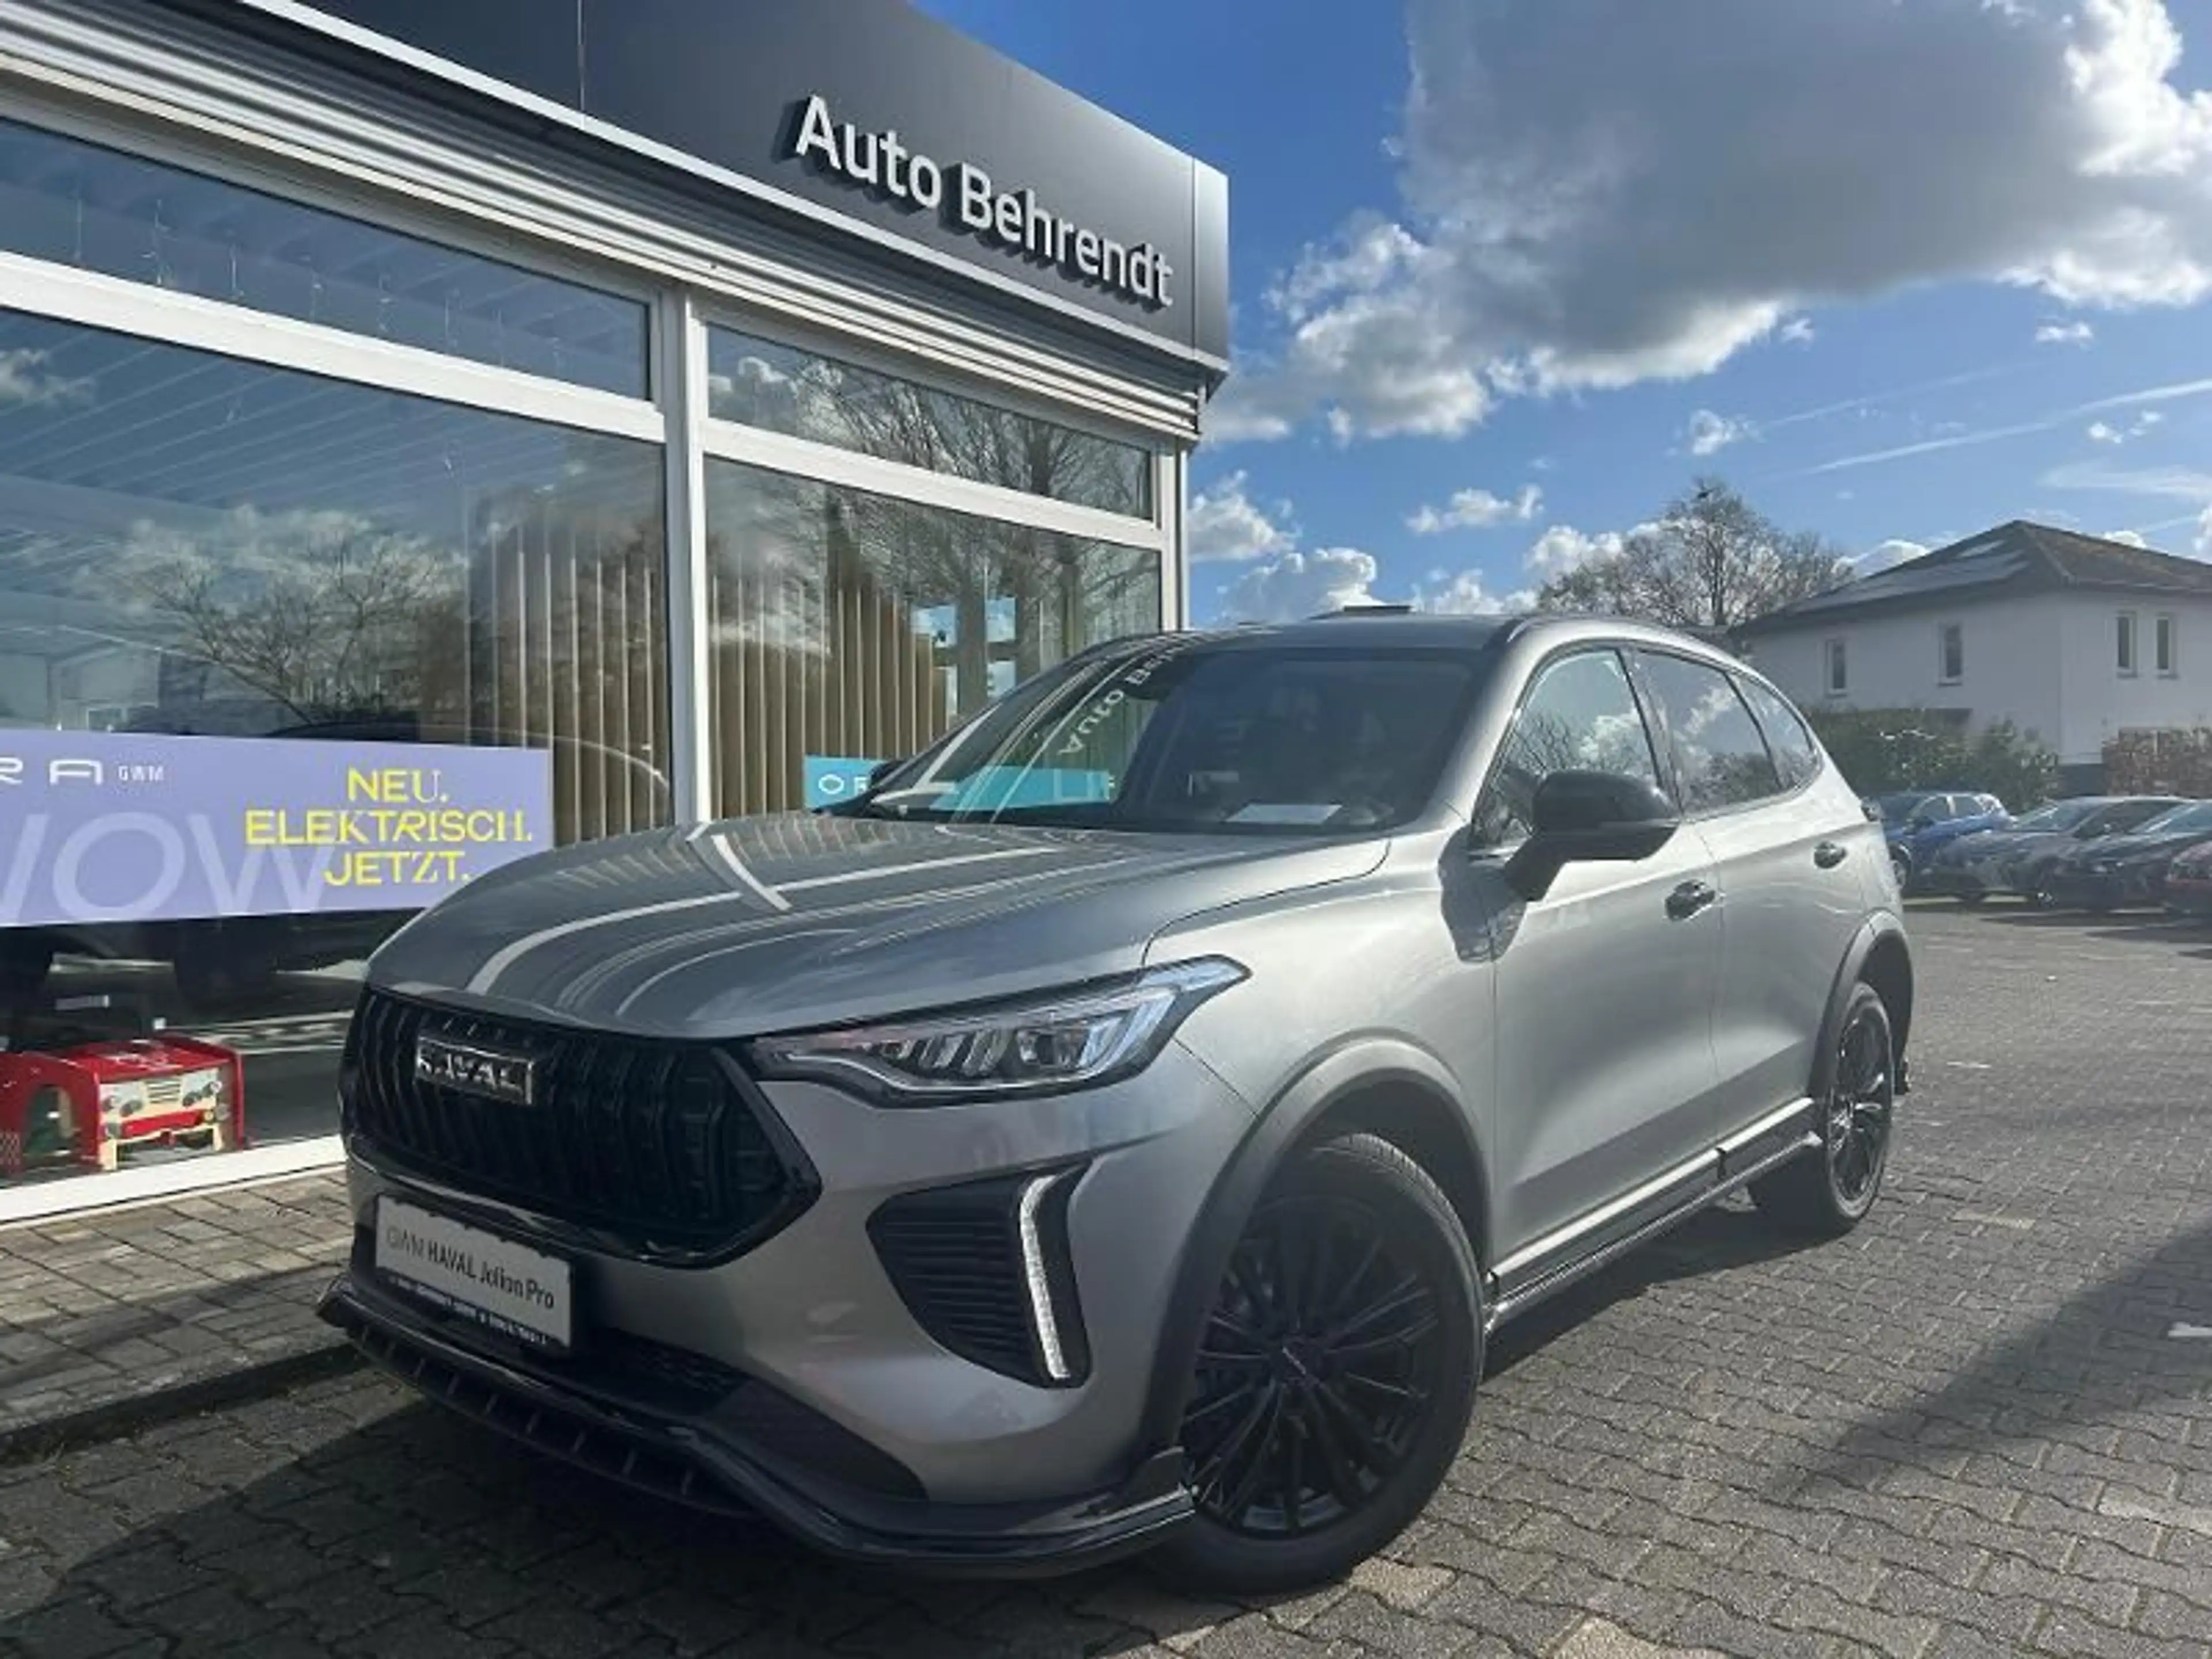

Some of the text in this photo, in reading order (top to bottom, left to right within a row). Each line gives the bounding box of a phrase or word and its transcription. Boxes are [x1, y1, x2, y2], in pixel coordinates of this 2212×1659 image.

[796, 95, 1173, 306] Auto Behrendt
[348, 769, 449, 803] NEU.
[245, 809, 532, 844] ELEKTRISCH.
[324, 851, 472, 886] JETZT.
[428, 1241, 477, 1279] HAVAL
[525, 1278, 554, 1309] Pro
